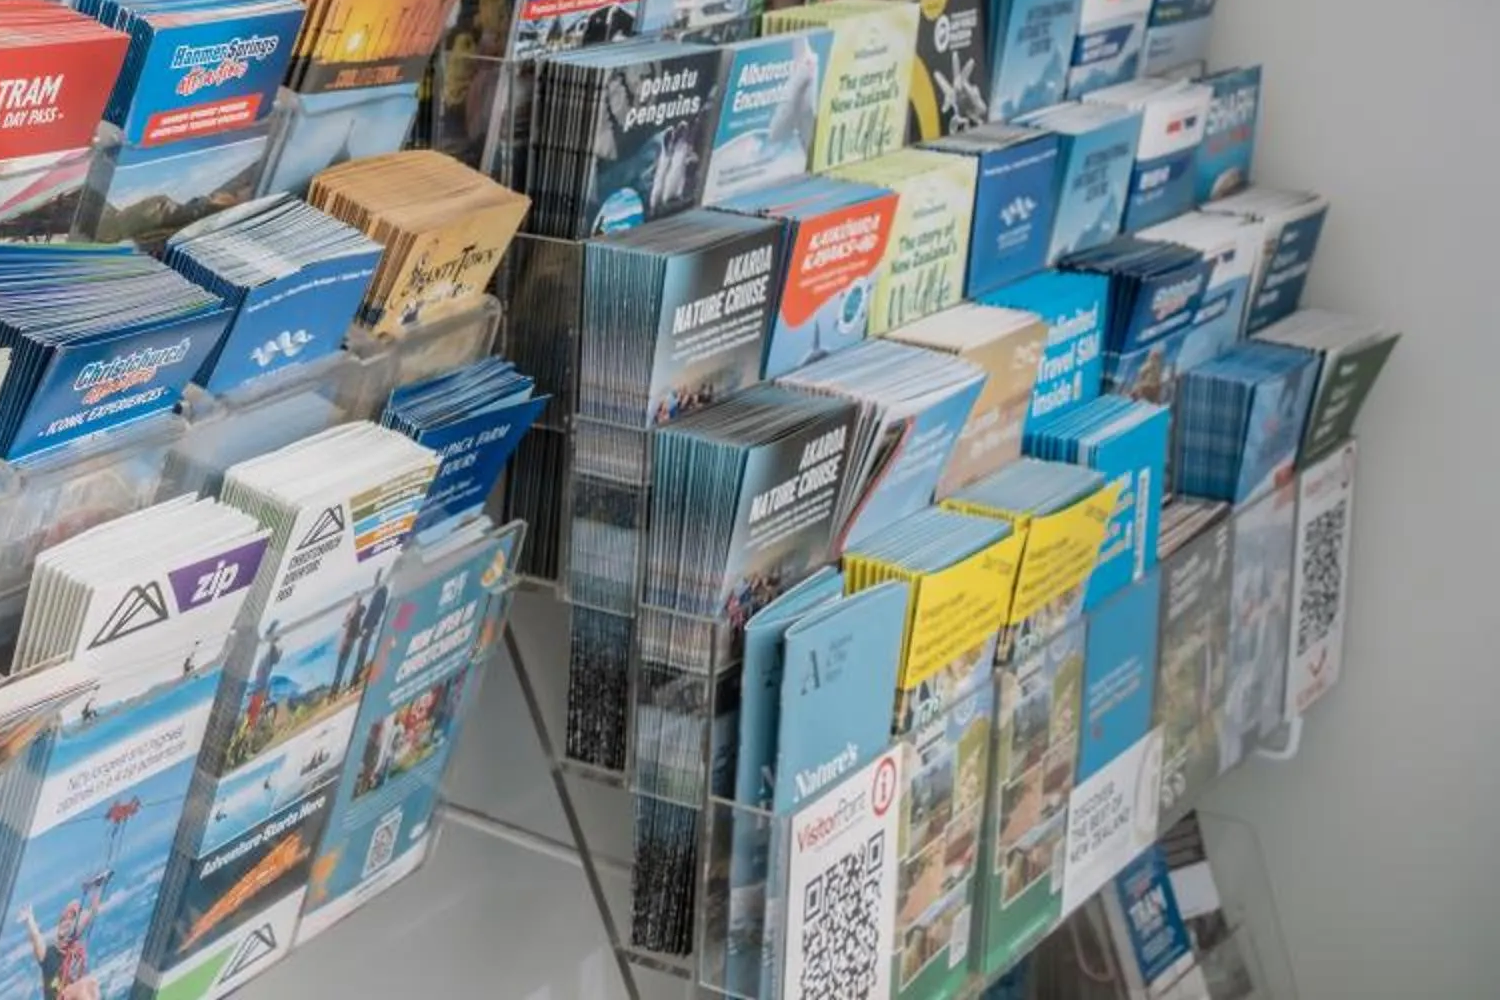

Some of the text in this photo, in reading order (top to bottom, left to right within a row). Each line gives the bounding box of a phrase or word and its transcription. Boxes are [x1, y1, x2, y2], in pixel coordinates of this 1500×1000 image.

[171, 35, 278, 70] Hanmer Springs
[640, 68, 698, 98] pohatu
[838, 75, 856, 94] The
[857, 70, 885, 92] story
[3, 110, 26, 129] DAY
[28, 108, 57, 125] PASS
[625, 95, 701, 132] penguins
[724, 245, 773, 285] AKAROA
[673, 293, 723, 335] NATURE
[724, 276, 768, 316] CRUISE
[74, 336, 191, 391] Christchurch
[799, 425, 846, 470] AKAROA
[751, 478, 796, 524] NATURE
[797, 455, 840, 500] CRUISE
[191, 560, 239, 602] zip
[794, 743, 860, 801] Nature's
